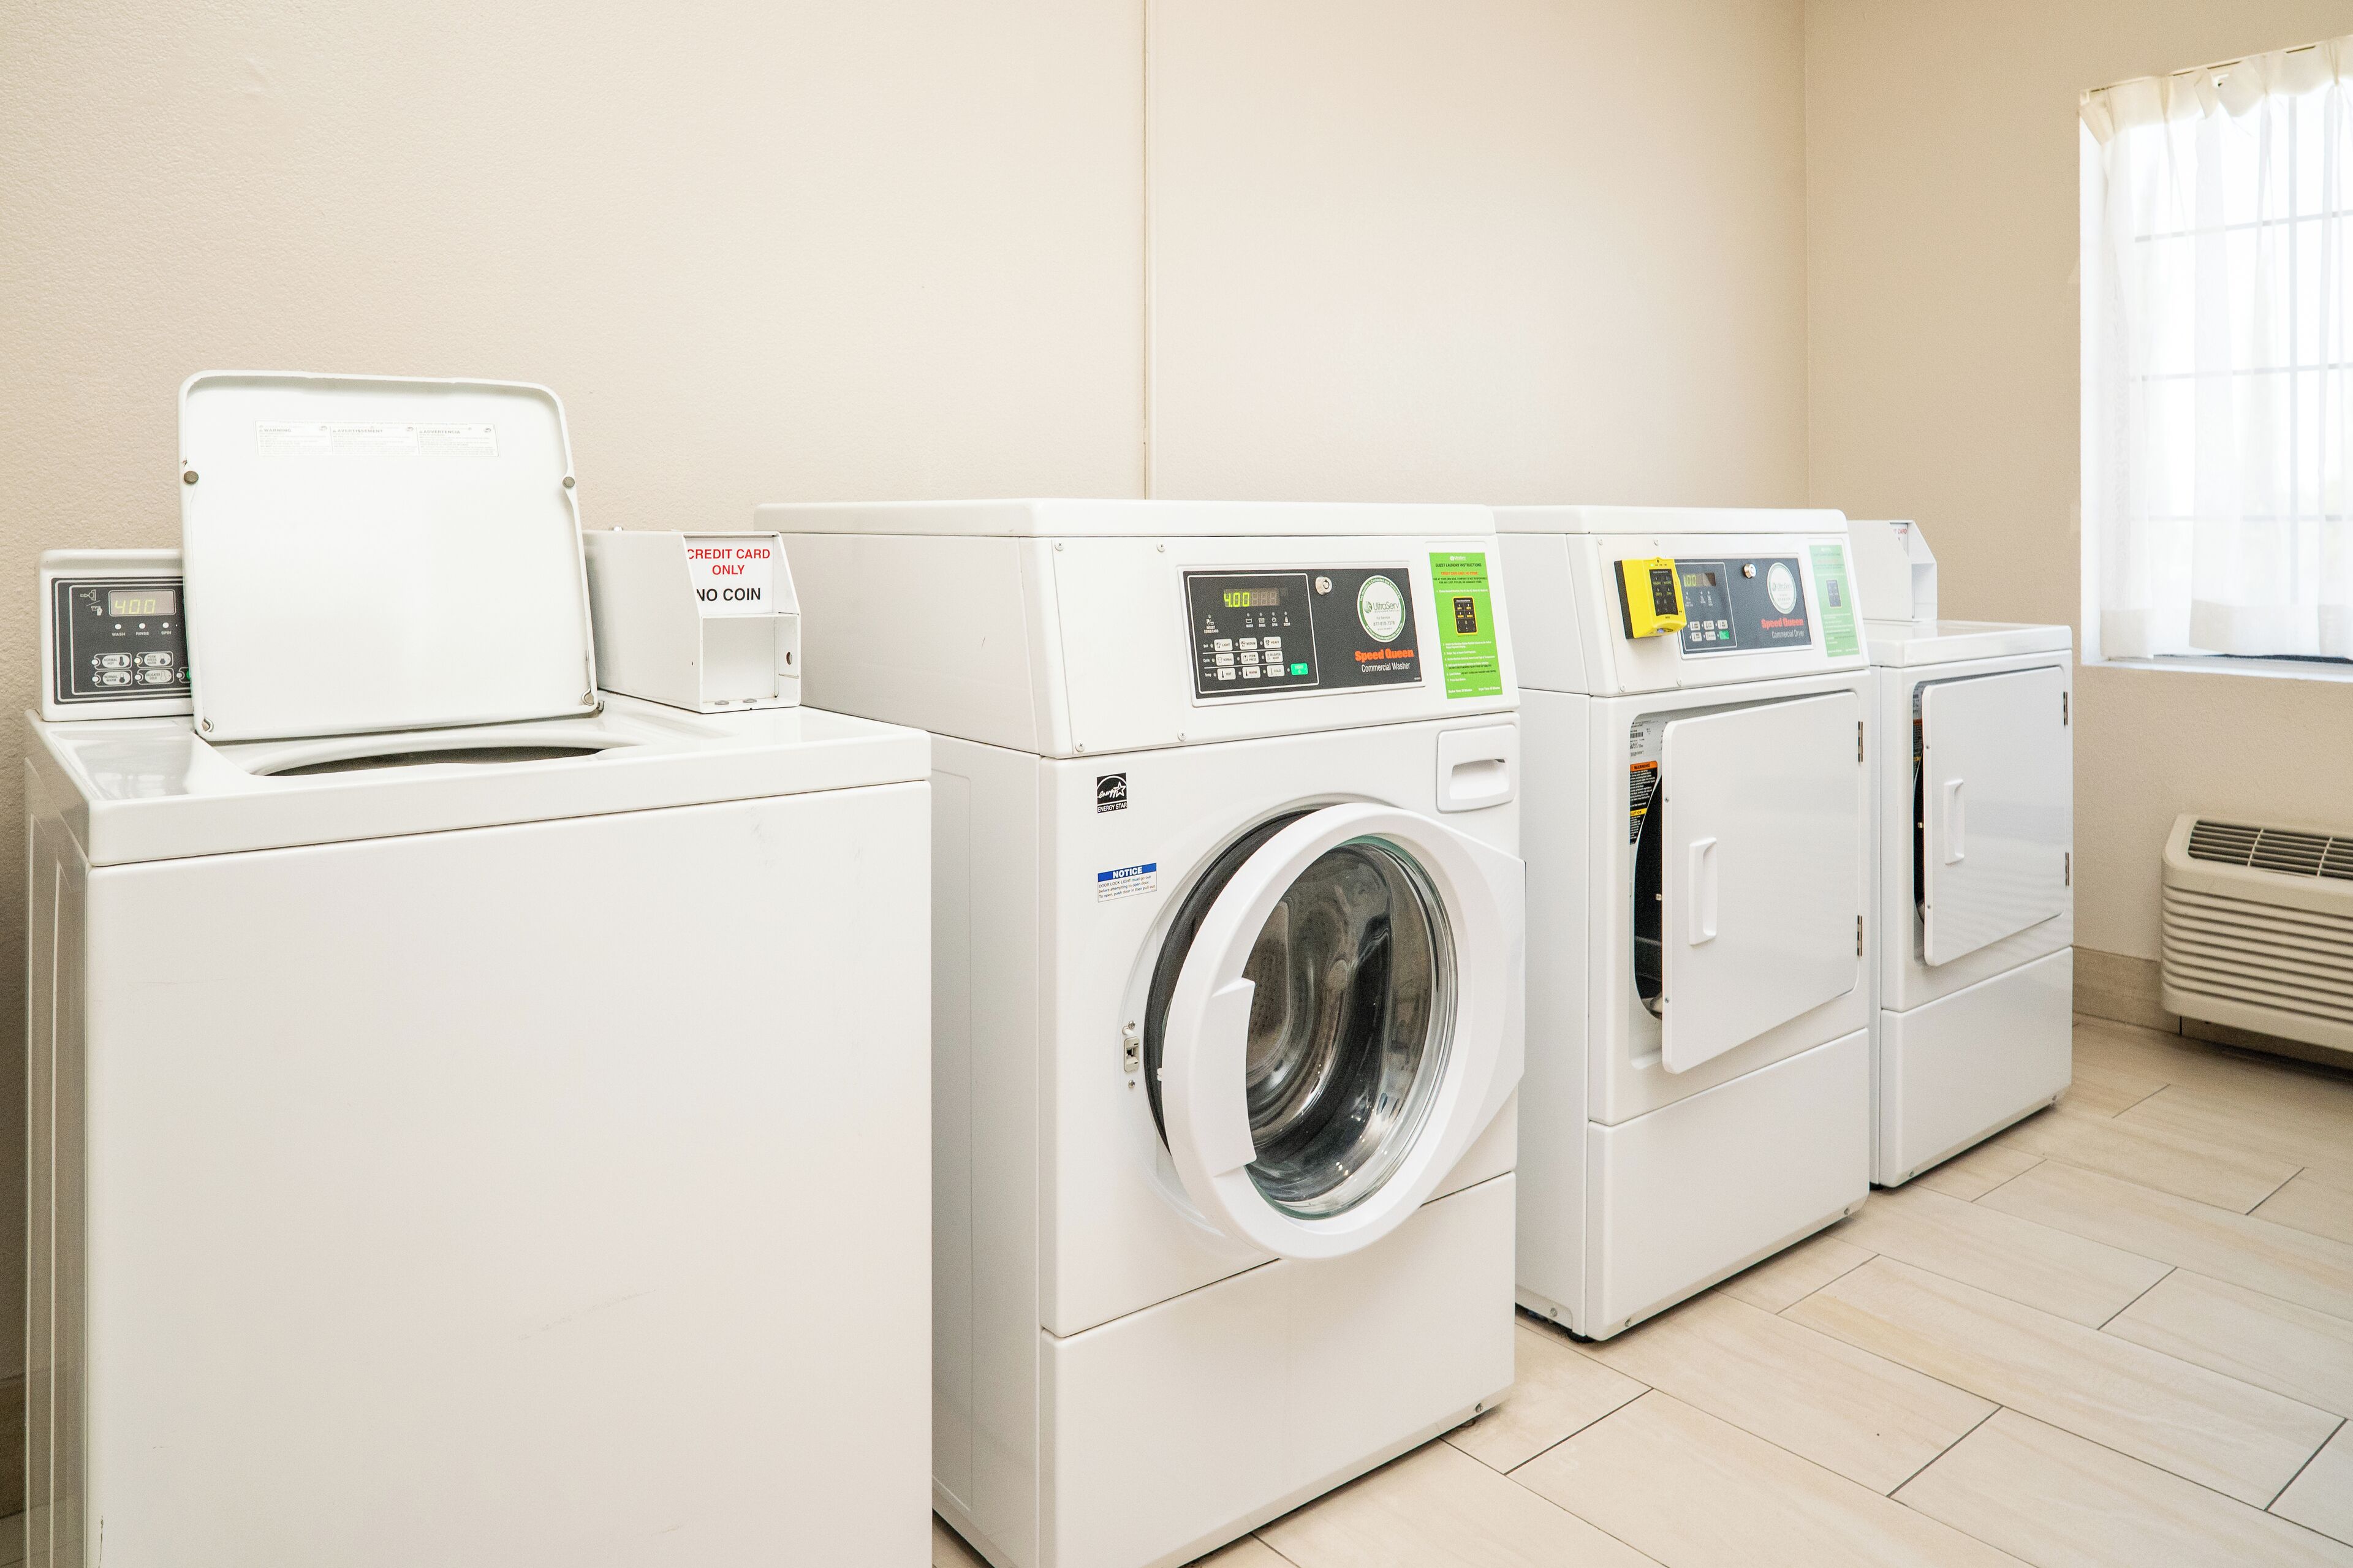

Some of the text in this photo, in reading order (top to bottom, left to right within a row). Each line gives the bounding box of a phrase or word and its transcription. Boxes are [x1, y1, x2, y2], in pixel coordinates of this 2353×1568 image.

[688, 549, 770, 559] CREDIT CARD
[712, 564, 745, 575] ONLY
[696, 588, 760, 601] NO COIN
[1373, 601, 1400, 610] UltraServ
[1761, 617, 1804, 630] Speed Queen
[1794, 629, 1805, 638] Dryer
[1355, 648, 1414, 663] Speed Queen
[1362, 662, 1410, 672] Commercial Washer
[1097, 804, 1115, 812] ENERGY
[1113, 866, 1143, 879] NOTICE
